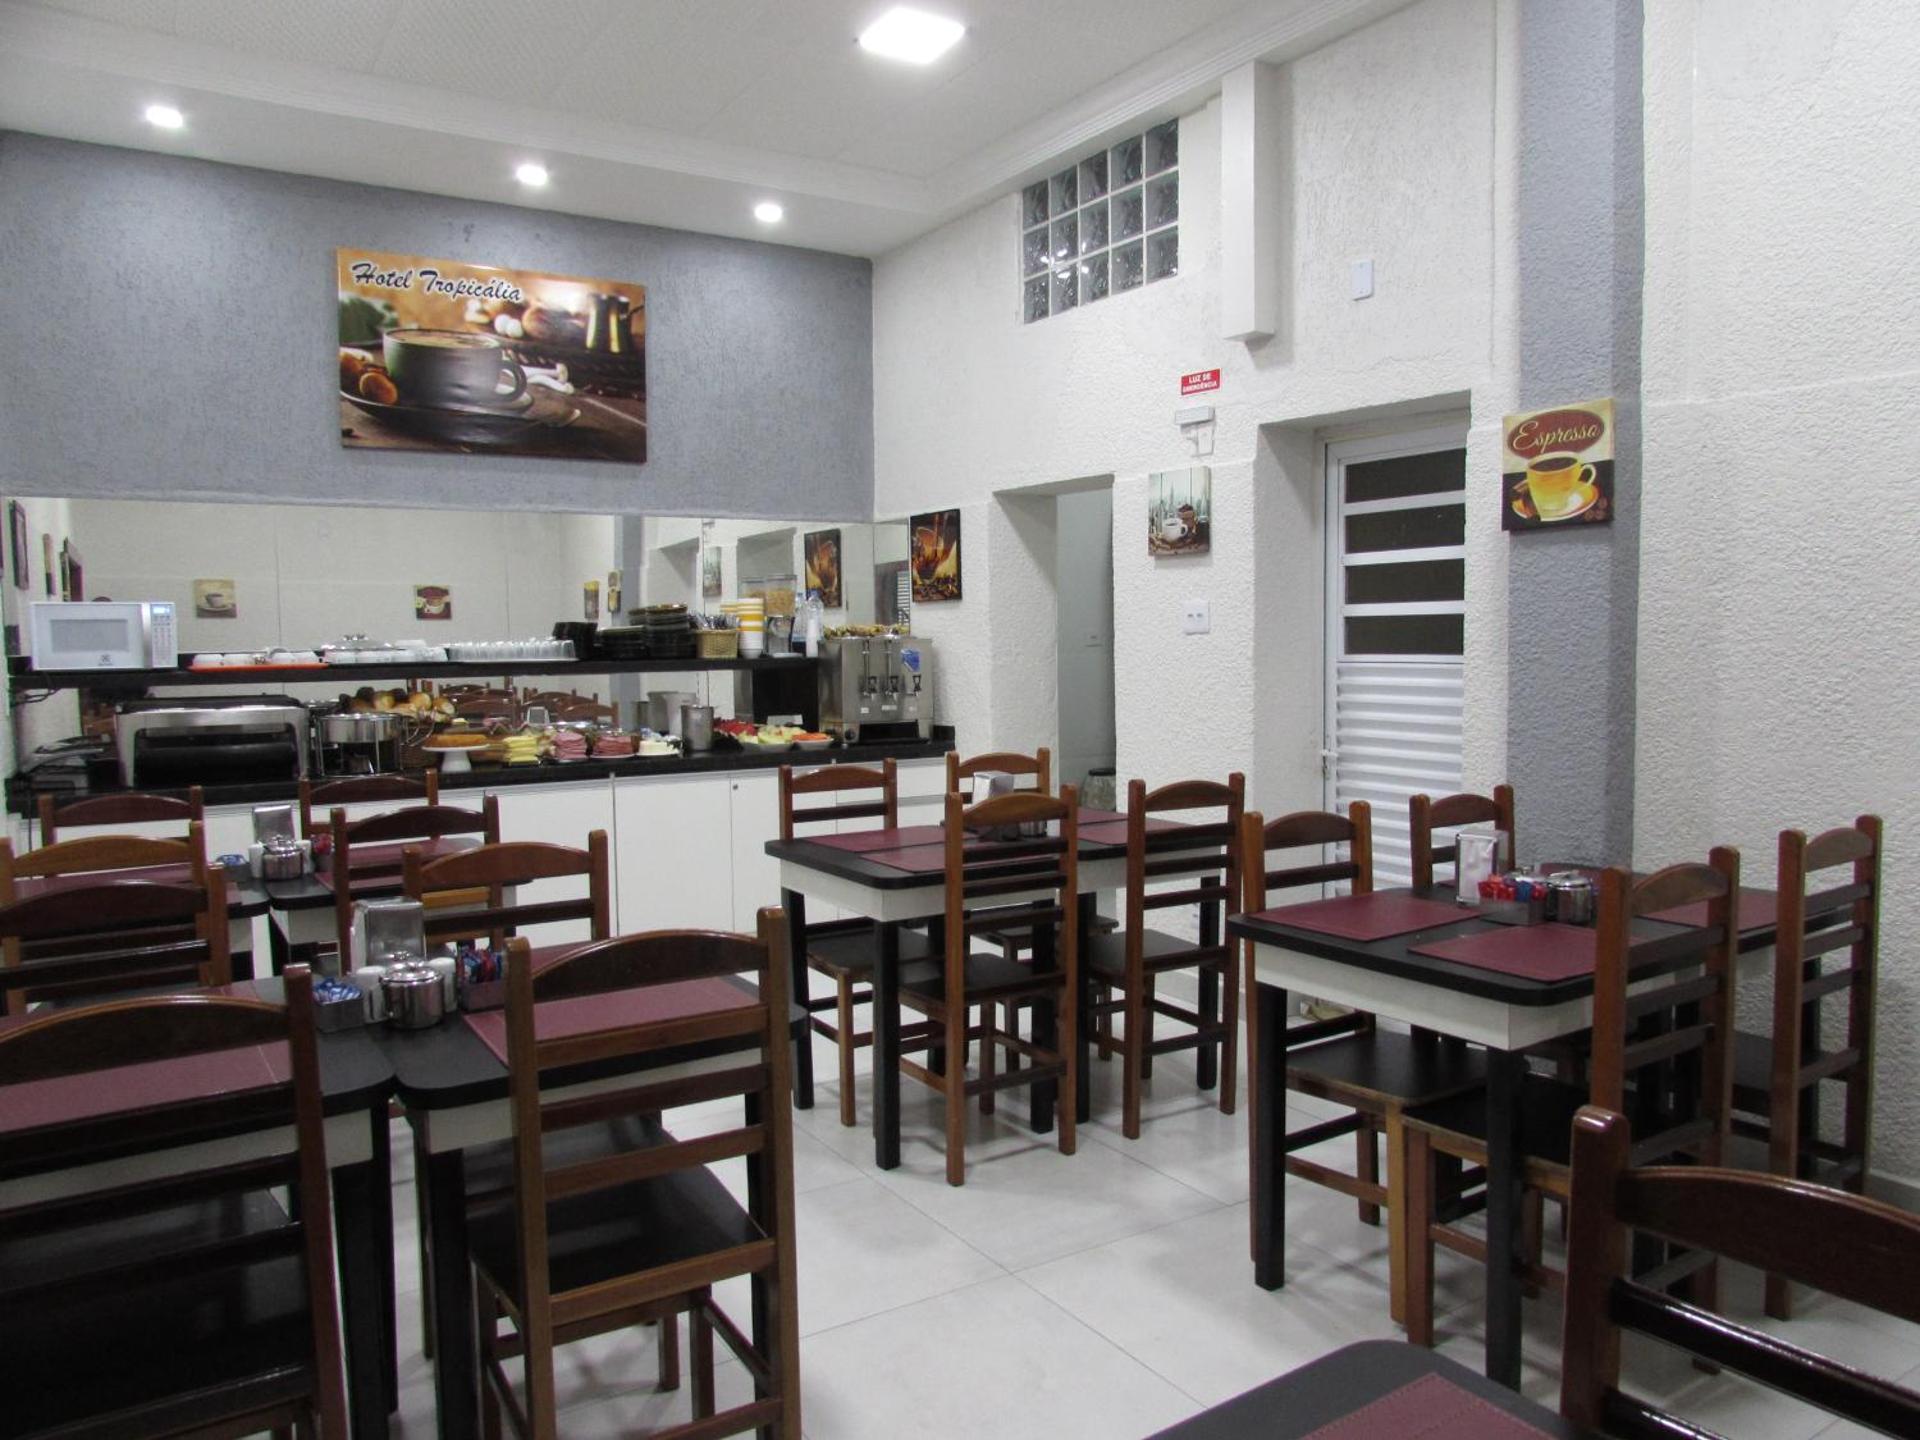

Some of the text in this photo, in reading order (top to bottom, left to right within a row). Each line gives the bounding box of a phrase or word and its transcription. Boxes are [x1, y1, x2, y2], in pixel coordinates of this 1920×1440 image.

[352, 263, 522, 300] Hotel Tropicália
[1189, 375, 1201, 385] LUZ
[1513, 420, 1598, 454] Espresso
